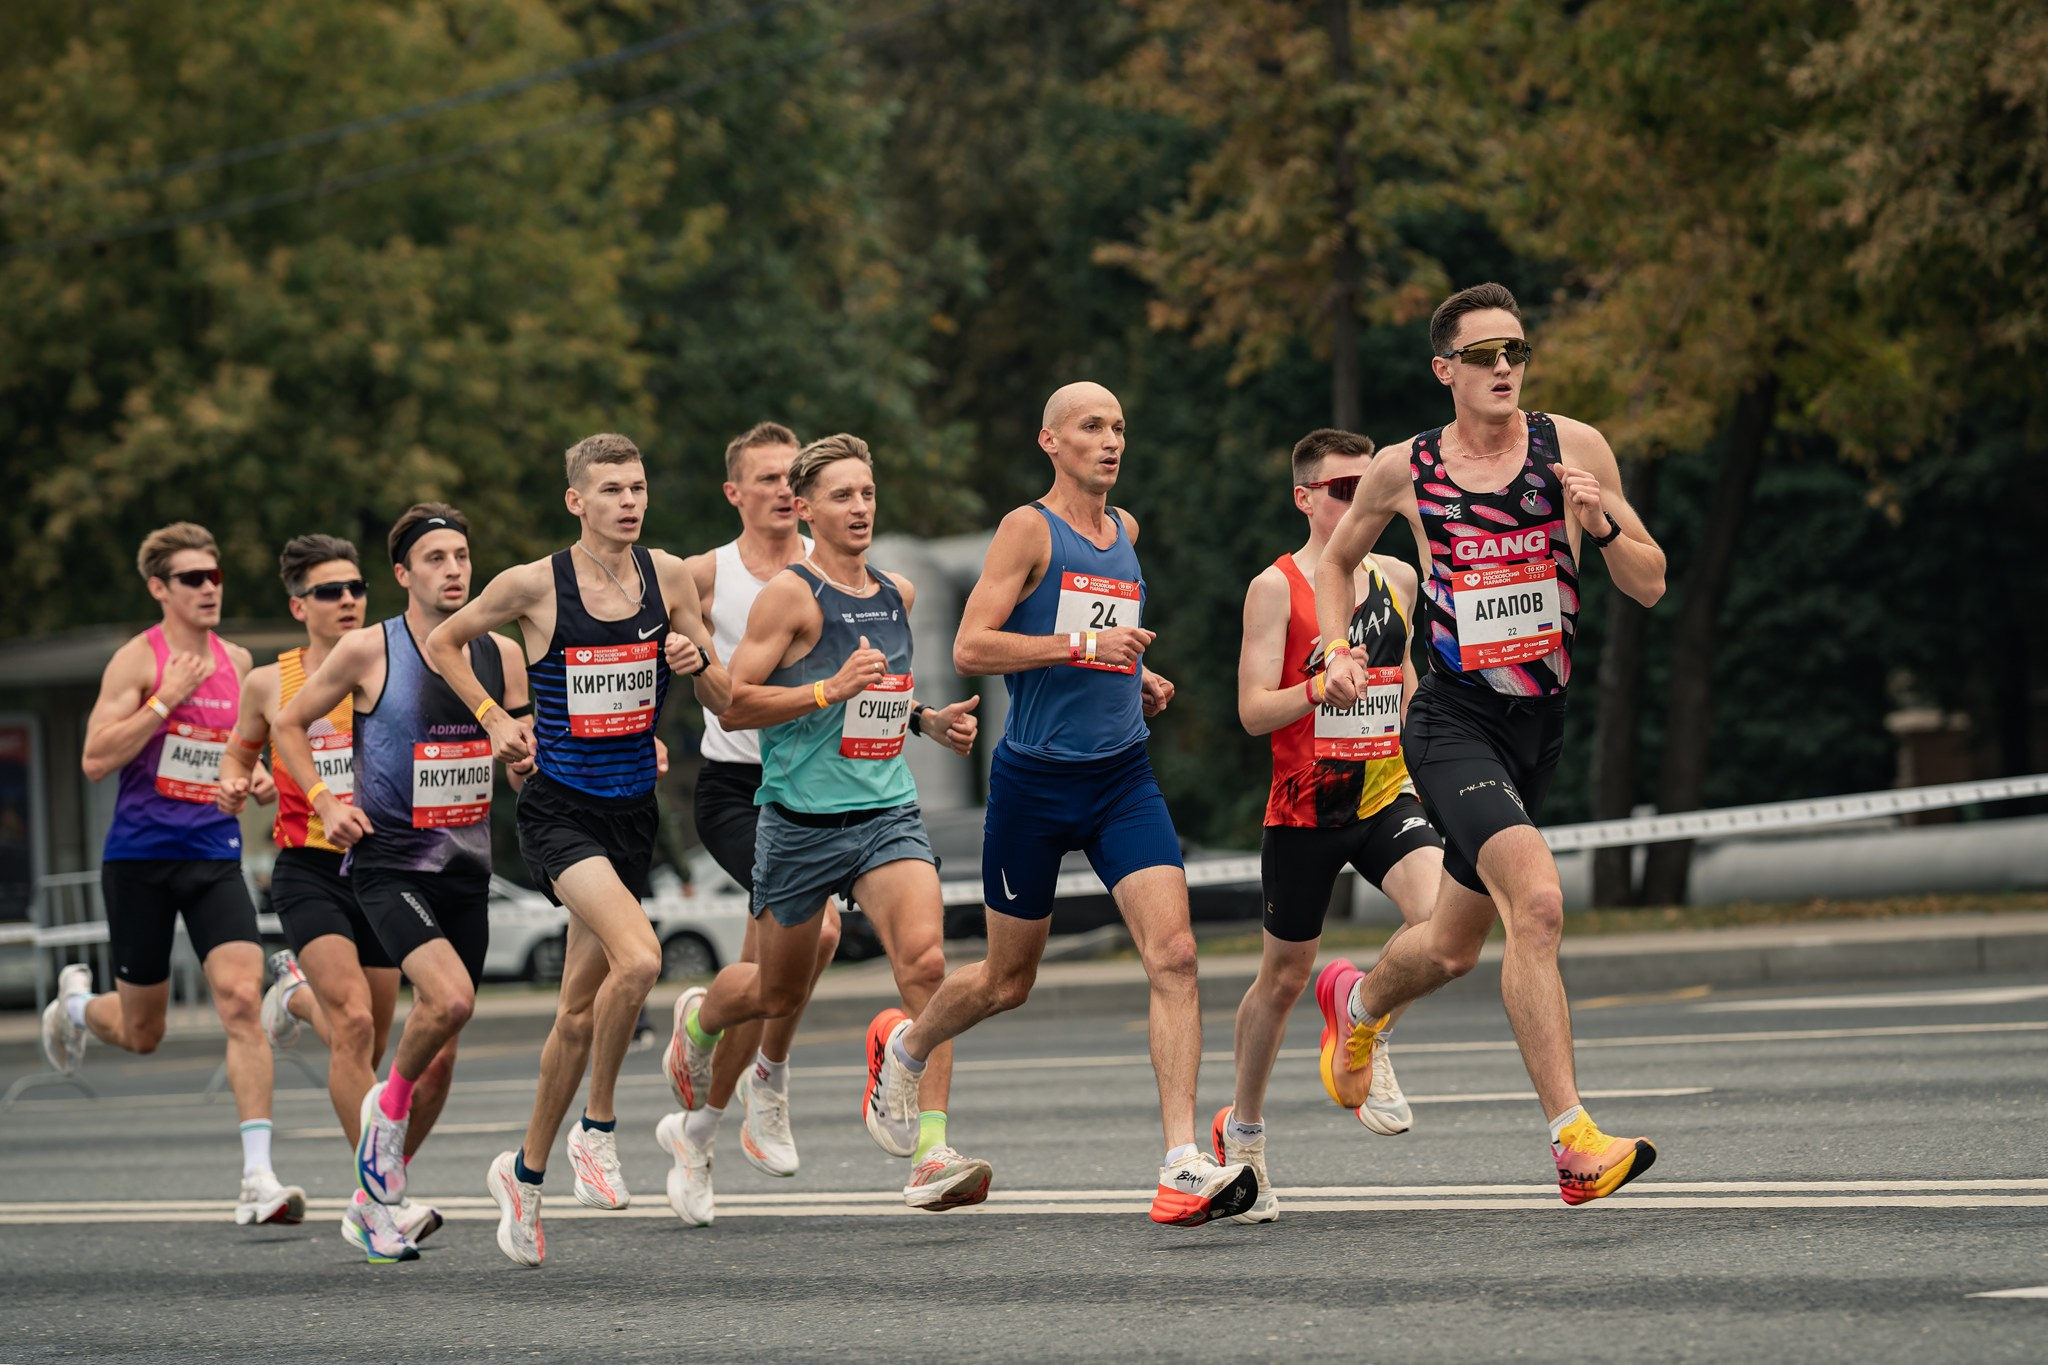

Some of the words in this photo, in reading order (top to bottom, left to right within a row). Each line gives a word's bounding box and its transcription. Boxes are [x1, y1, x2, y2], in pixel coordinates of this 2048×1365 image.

[1455, 530, 1546, 561] GANG
[1482, 568, 1510, 576] СБЕРПРАЙМ
[1482, 571, 1520, 581] МОСКОВСКИЙ
[1483, 578, 1511, 586] МАРАФОН
[1475, 592, 1544, 621] АГАПОВ
[1089, 601, 1118, 629] 24
[1507, 627, 1517, 636] 22
[573, 669, 653, 694] КИРГИЗОВ
[613, 702, 623, 710] 23
[859, 699, 909, 723] СУЩЕНЯ
[428, 724, 478, 735] ADIXION
[882, 728, 889, 736] 11
[1361, 726, 1370, 735] 27
[171, 744, 221, 768] АНДРЕЕ
[419, 765, 490, 787] ЯКУТИЛОВ
[453, 794, 462, 802] 20
